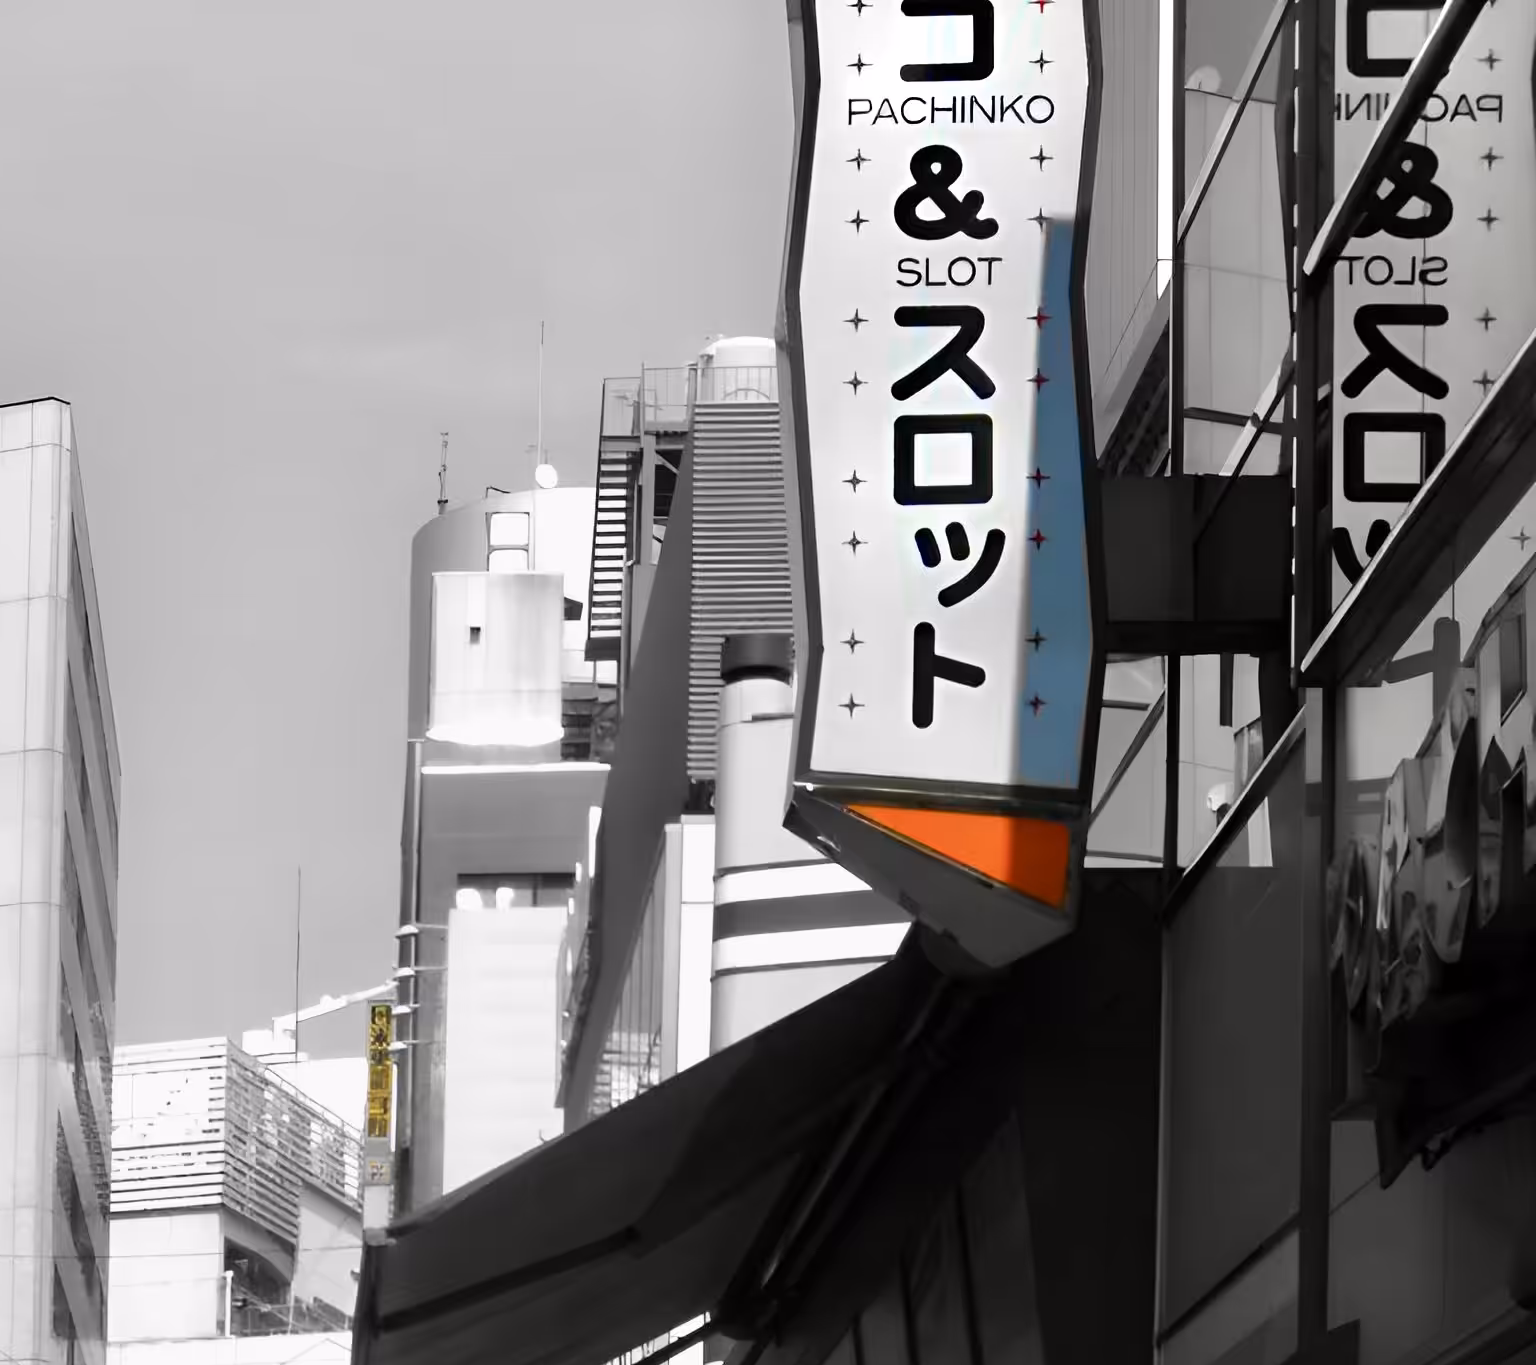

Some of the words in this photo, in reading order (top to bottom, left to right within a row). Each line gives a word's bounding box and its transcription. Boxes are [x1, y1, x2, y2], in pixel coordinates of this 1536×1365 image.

[847, 94, 1055, 126] PACHINKO
[893, 144, 999, 240] &
[896, 256, 1003, 287] SLOT
[890, 305, 1006, 729] スロット
